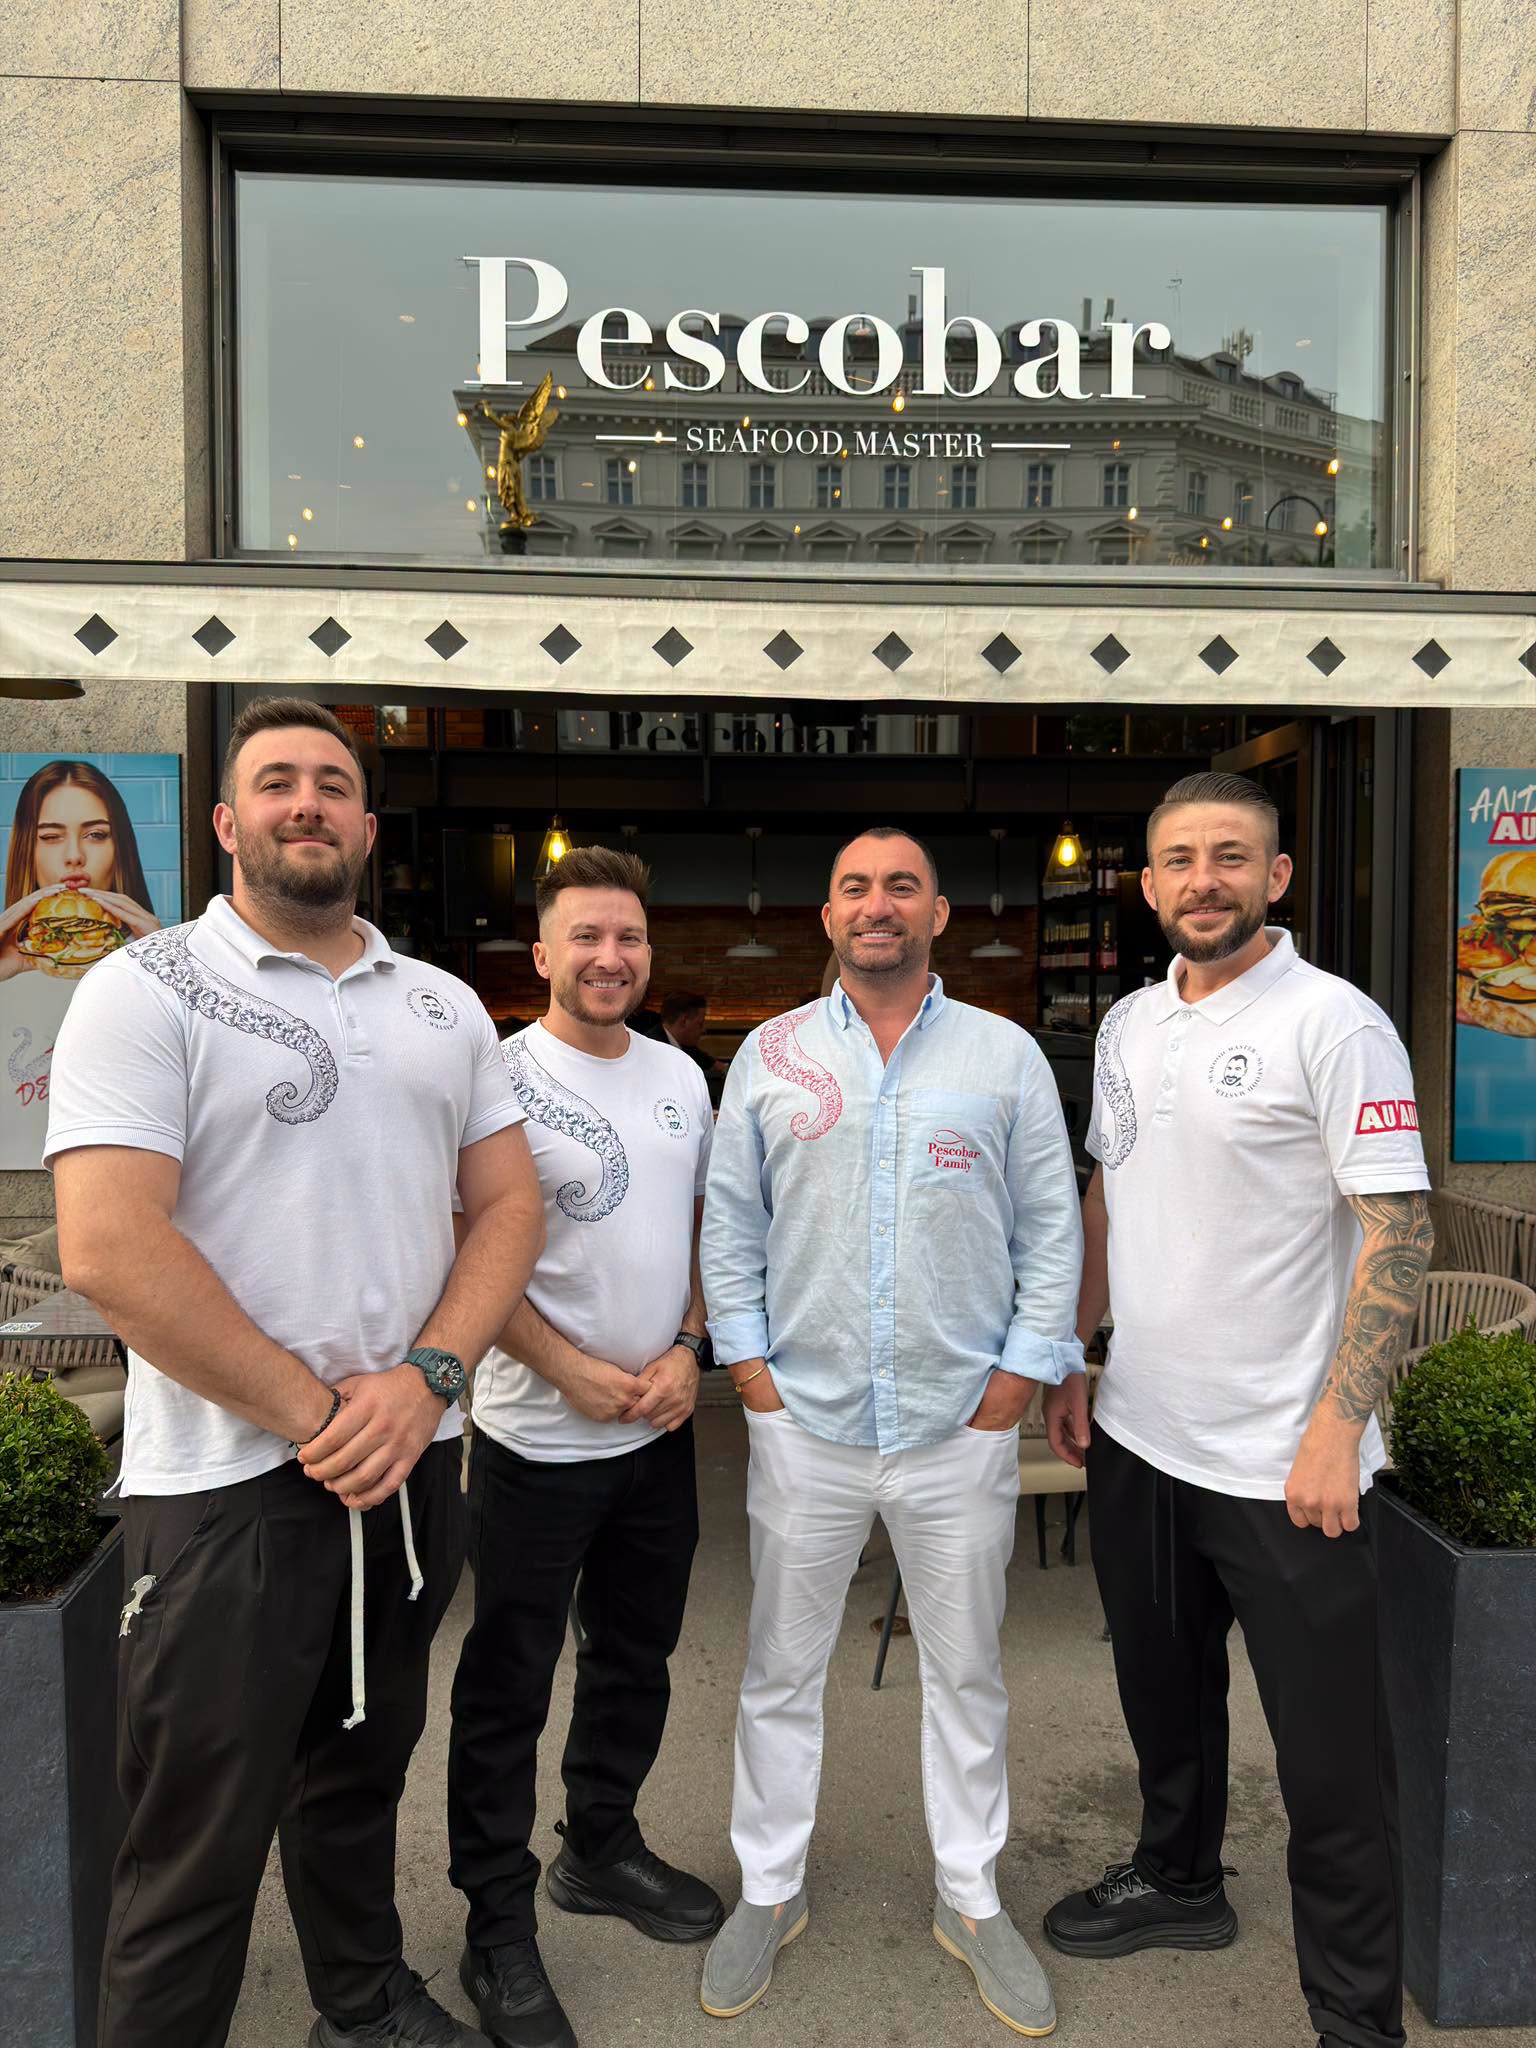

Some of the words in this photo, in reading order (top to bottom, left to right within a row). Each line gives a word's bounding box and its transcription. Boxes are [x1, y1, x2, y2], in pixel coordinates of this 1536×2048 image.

[463, 256, 1171, 400] Pescobar
[686, 427, 843, 455] SEAFOOD
[853, 431, 985, 458] MASTER
[928, 1142, 981, 1158] Pescobar
[935, 1155, 972, 1174] Family
